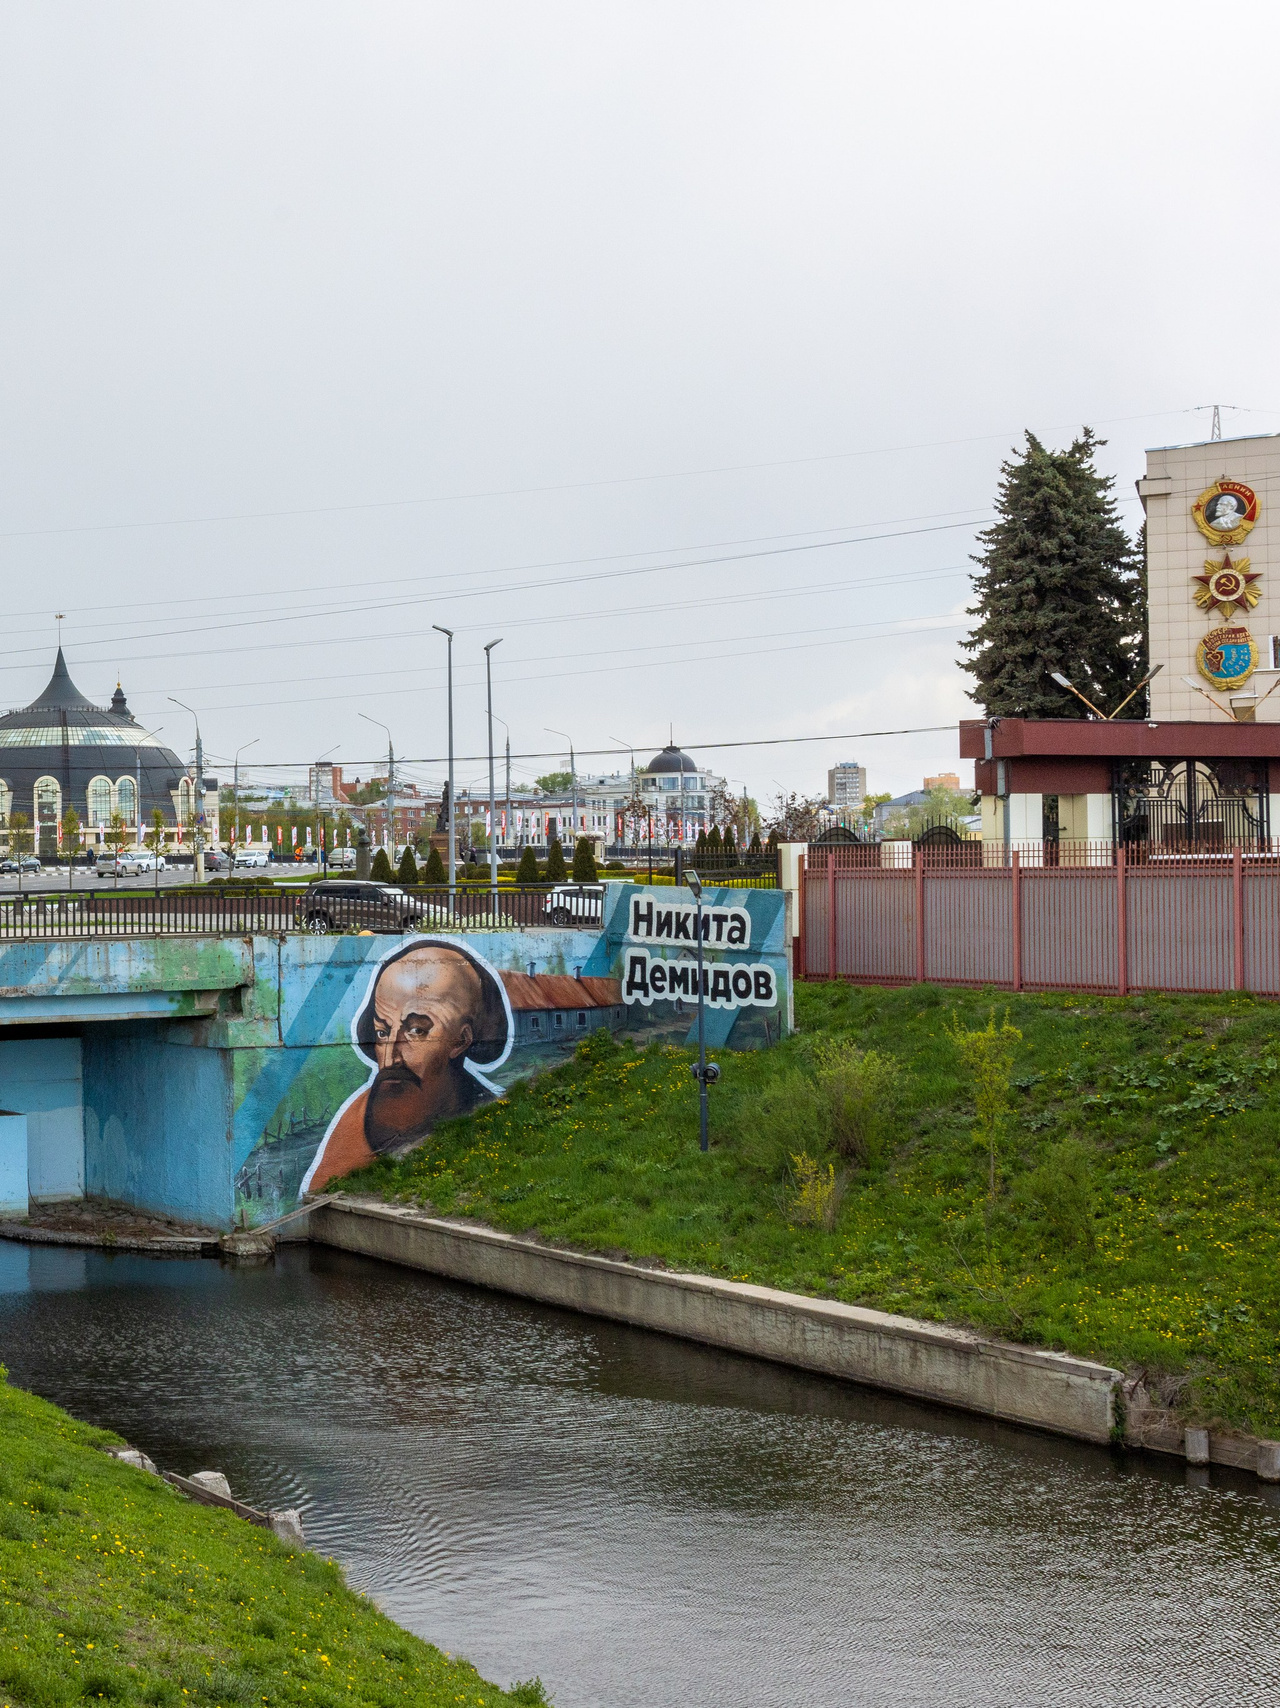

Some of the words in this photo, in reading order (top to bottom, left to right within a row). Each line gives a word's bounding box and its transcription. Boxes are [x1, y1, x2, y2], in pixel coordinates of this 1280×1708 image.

[1222, 484, 1252, 497] ЛЕНИН
[632, 900, 747, 945] Никита
[626, 955, 773, 1002] Демидов
